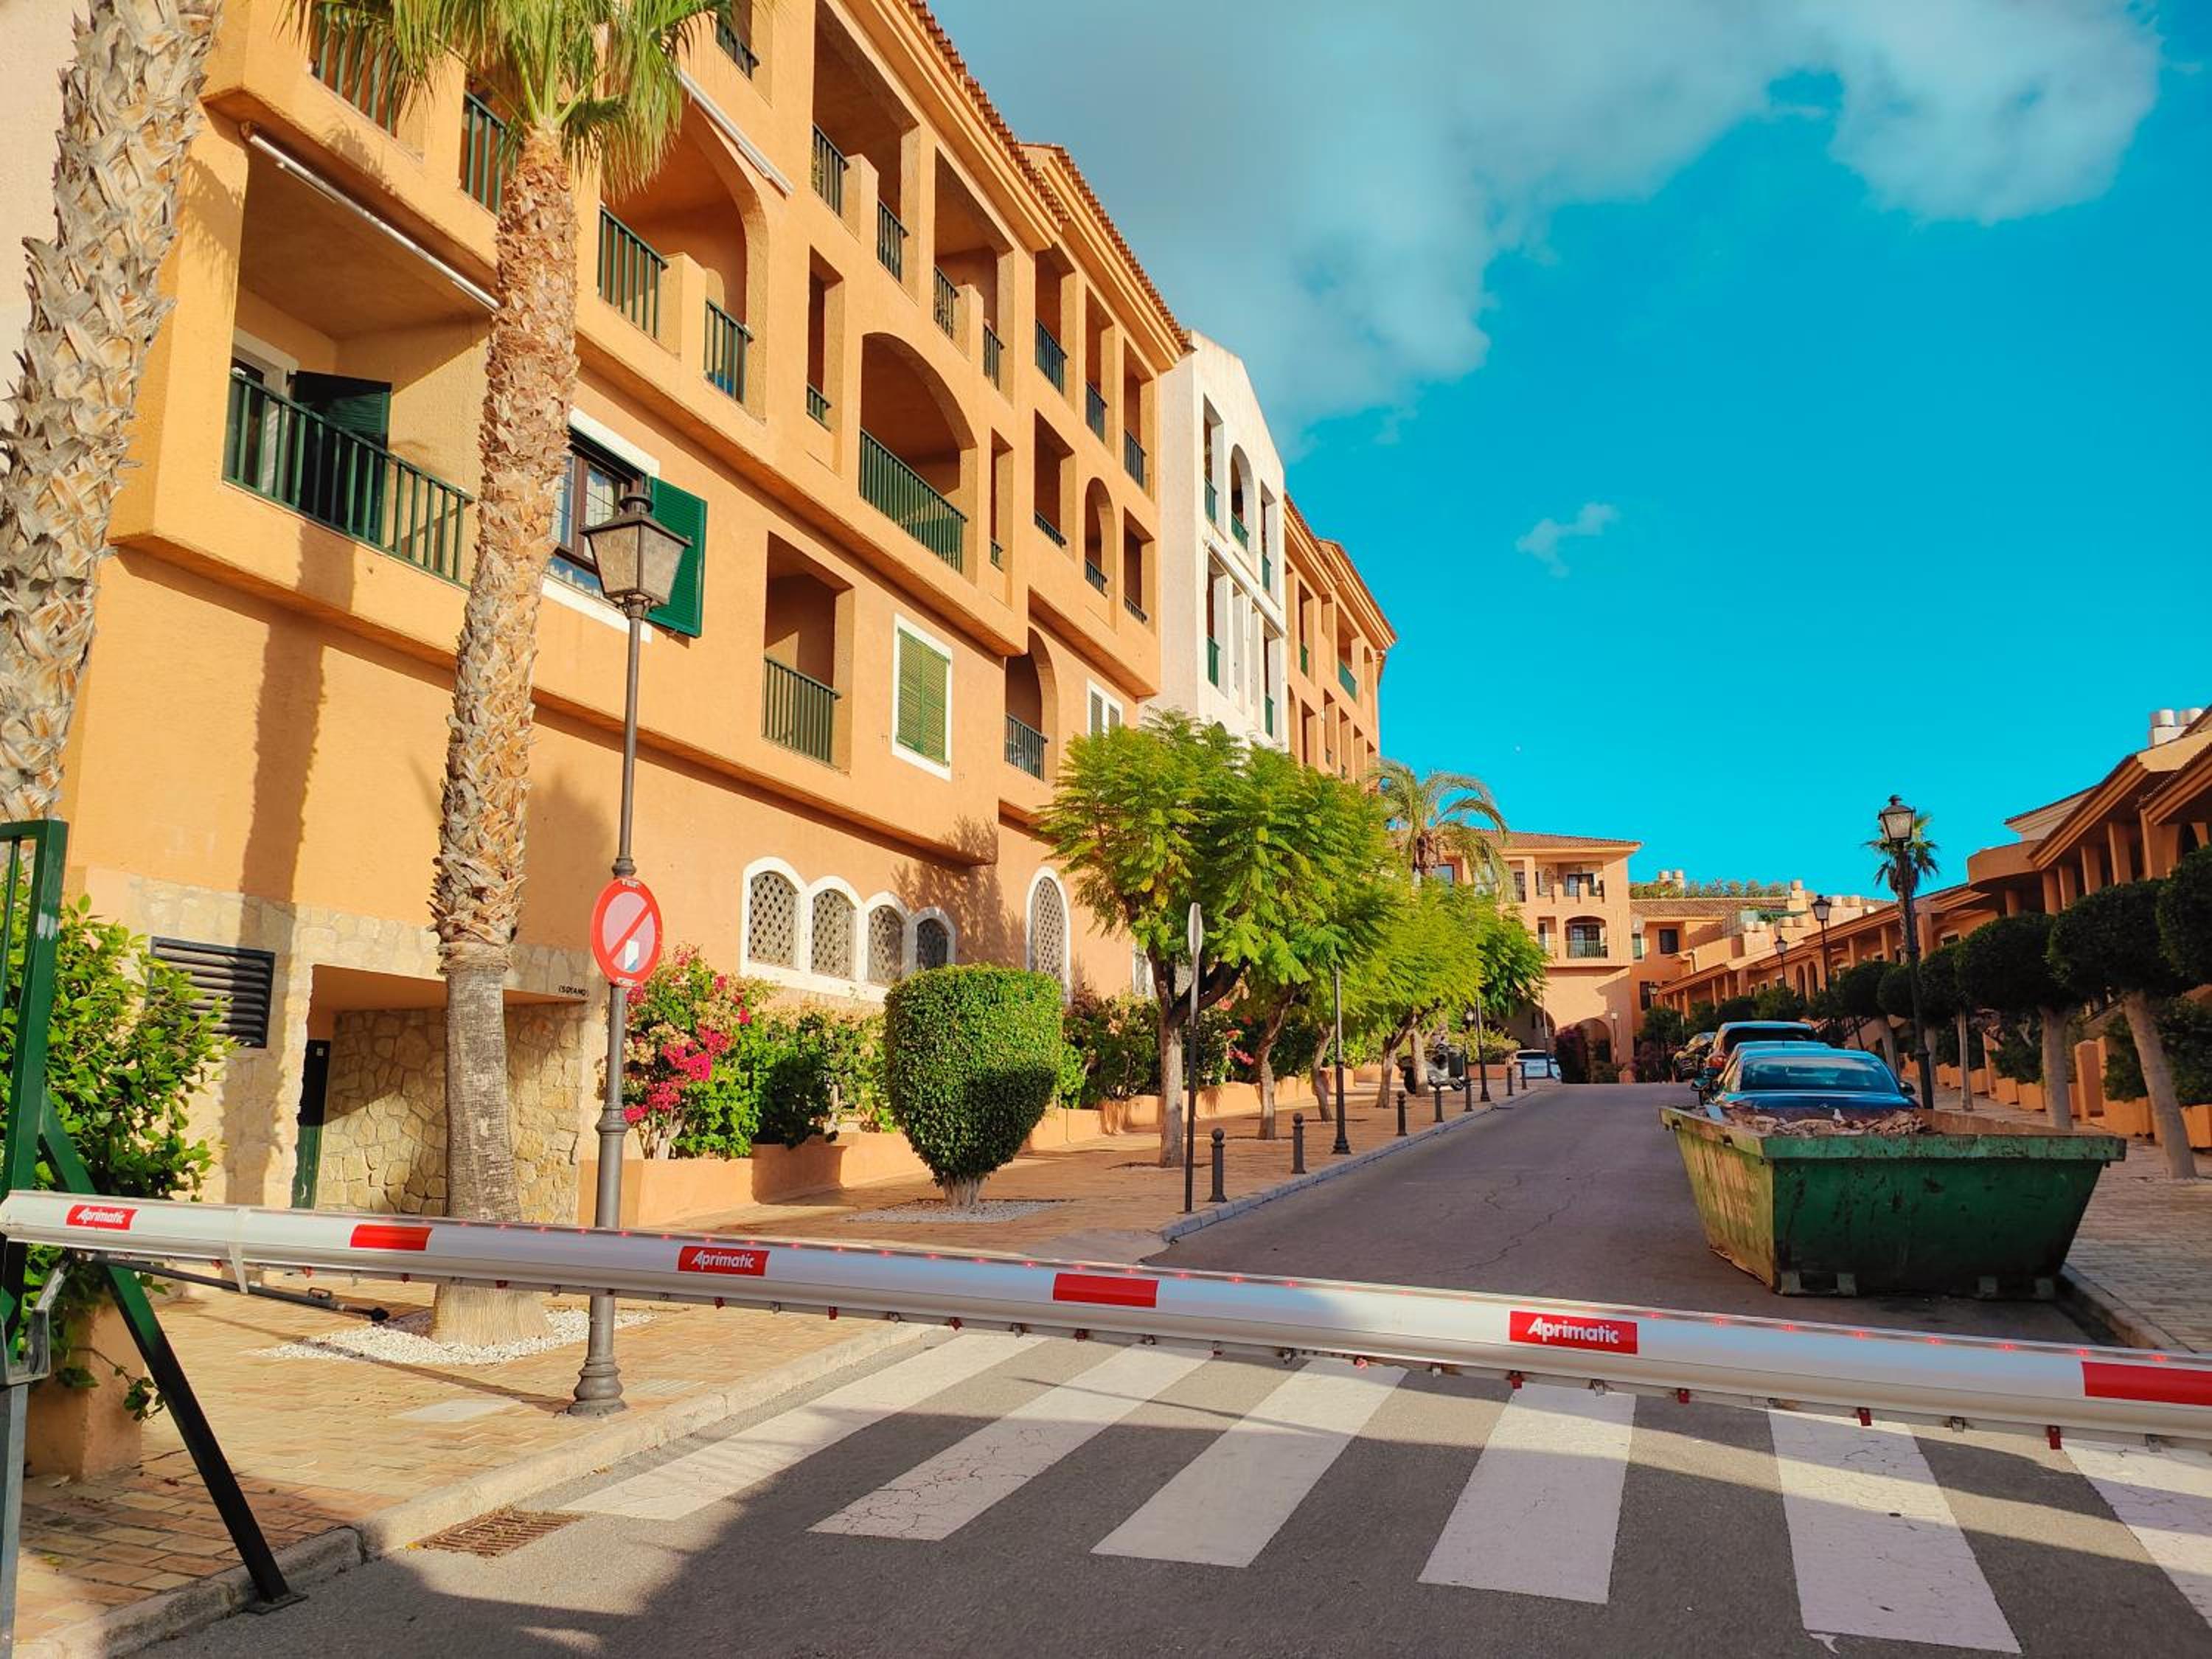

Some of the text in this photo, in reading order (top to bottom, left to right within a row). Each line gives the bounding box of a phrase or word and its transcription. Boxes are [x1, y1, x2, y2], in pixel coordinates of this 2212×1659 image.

[76, 1207, 125, 1225] Aprimatic
[691, 1250, 755, 1270] Aprimatic
[1527, 1316, 1619, 1344] Aprimatic
